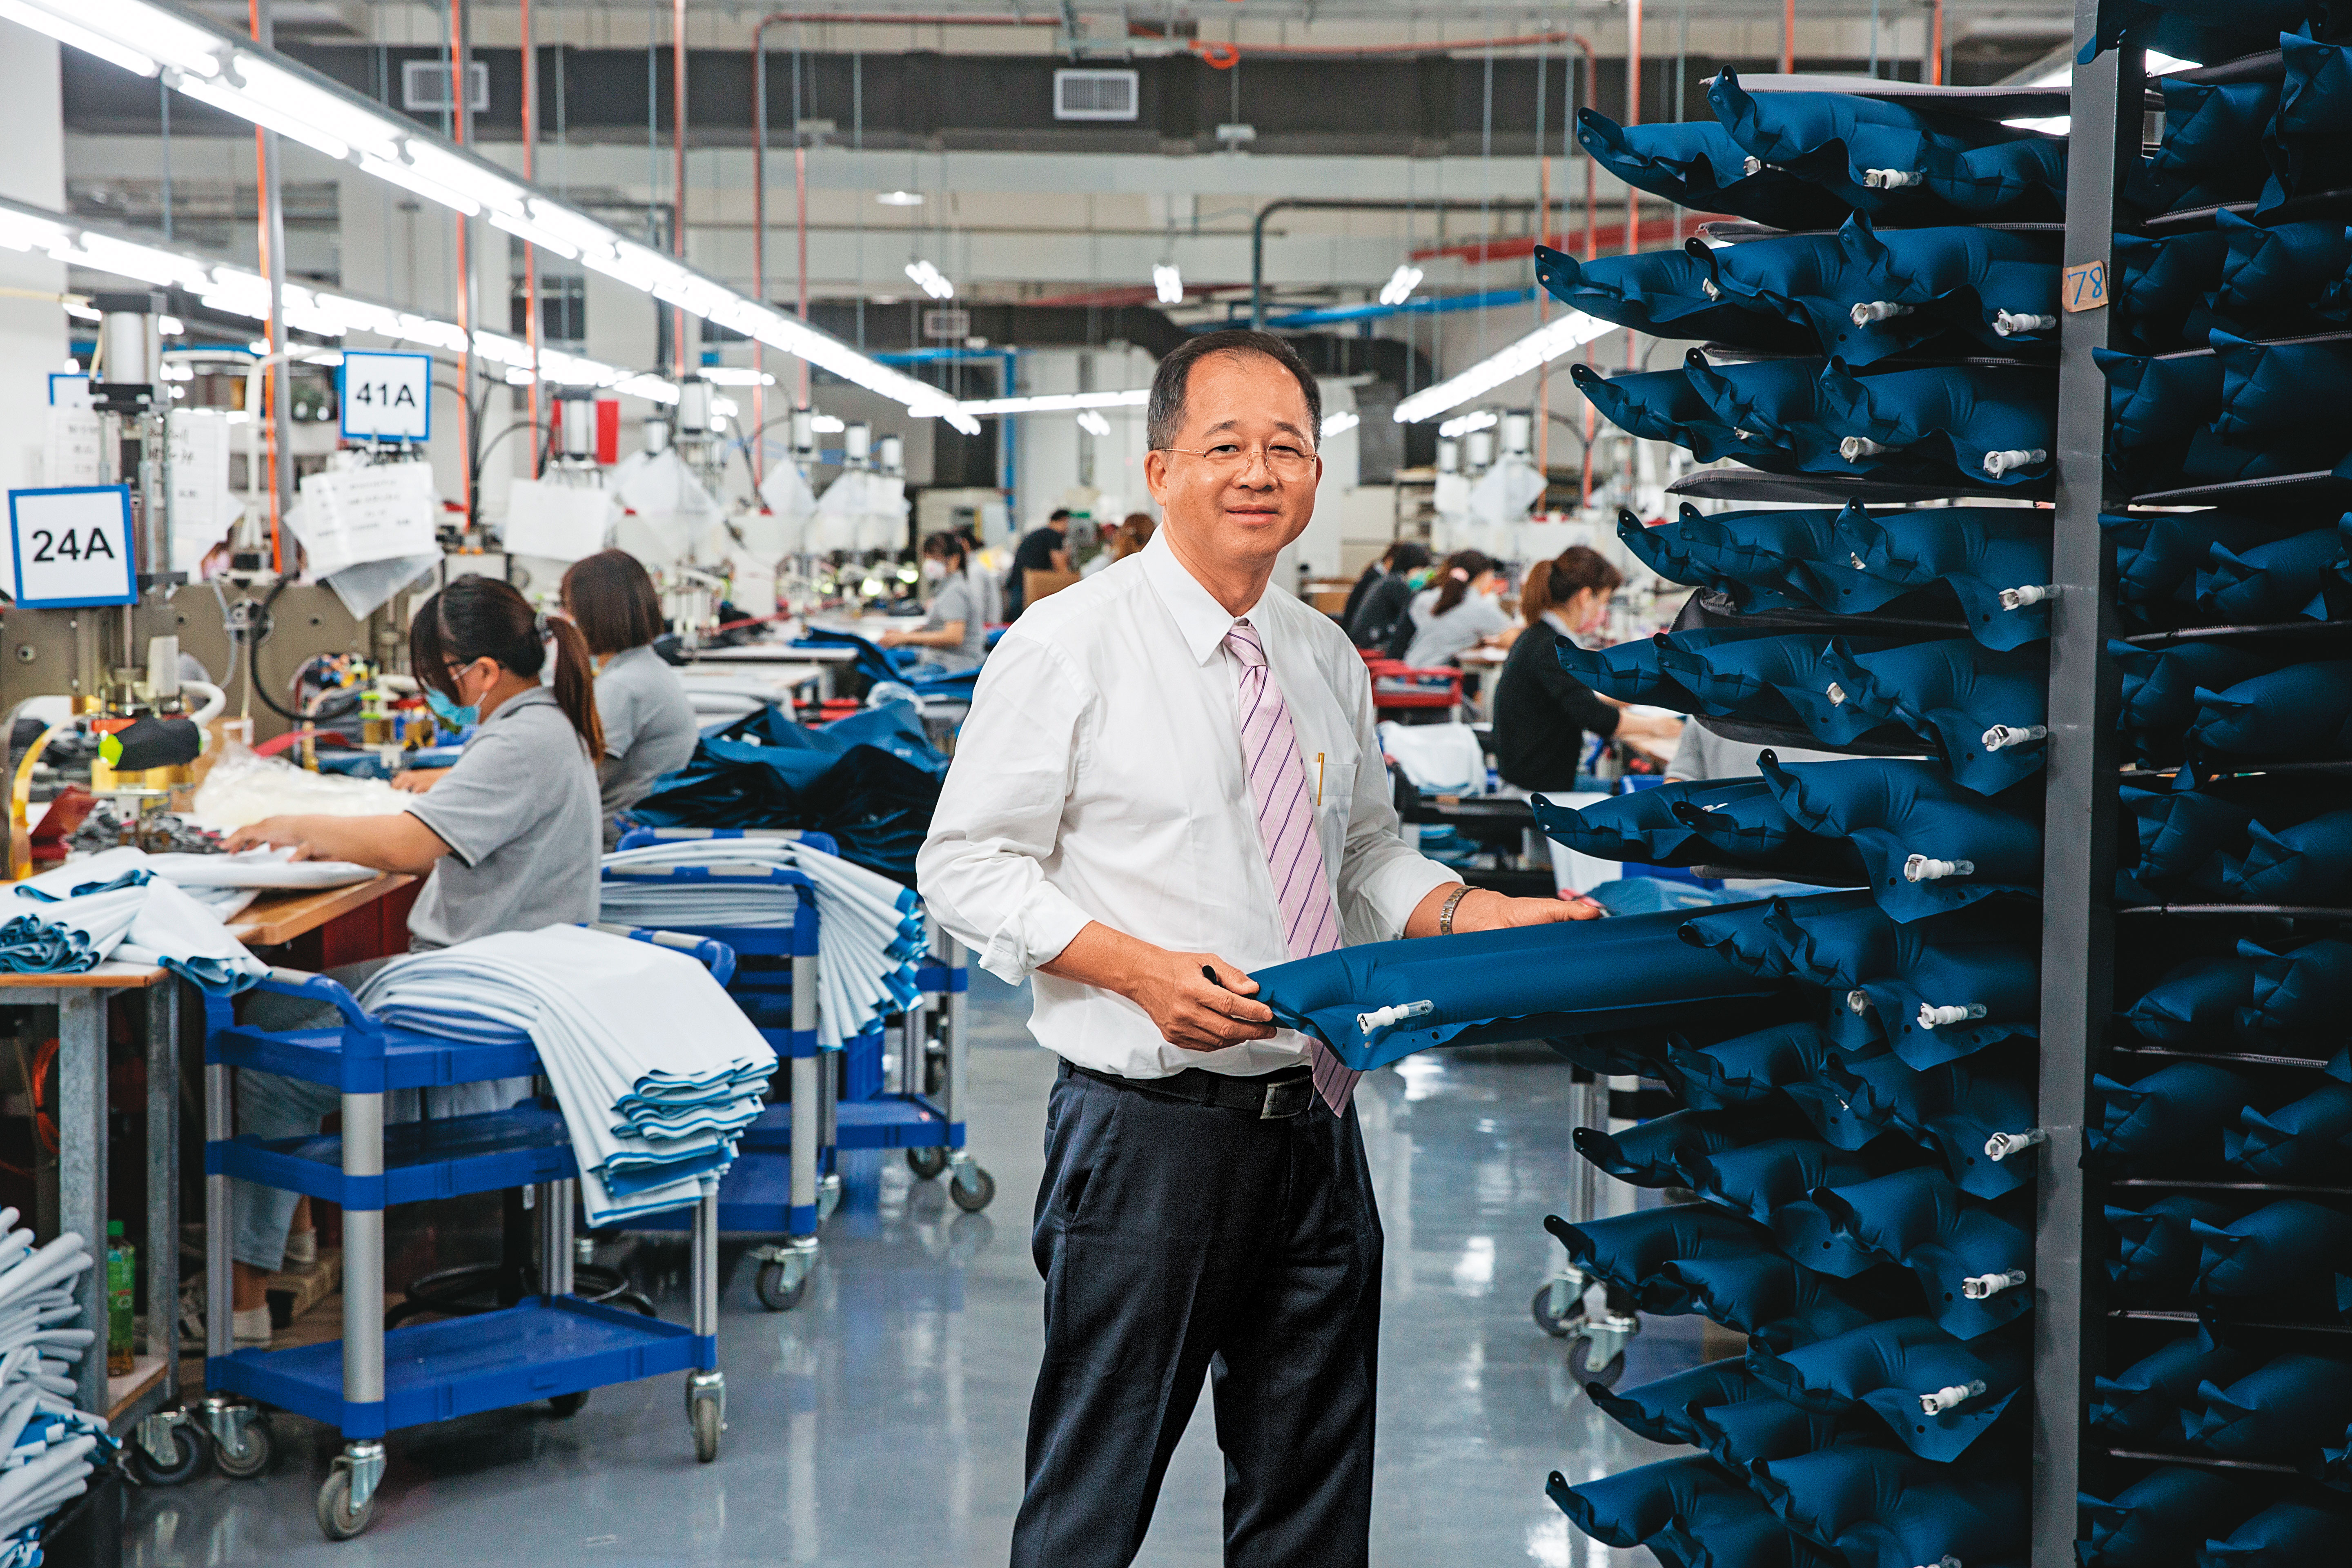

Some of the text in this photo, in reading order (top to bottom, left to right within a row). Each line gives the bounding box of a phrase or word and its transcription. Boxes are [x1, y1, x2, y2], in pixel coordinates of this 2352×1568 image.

[2067, 266, 2103, 305] 78
[356, 383, 416, 407] 41A
[32, 528, 115, 562] 24A
